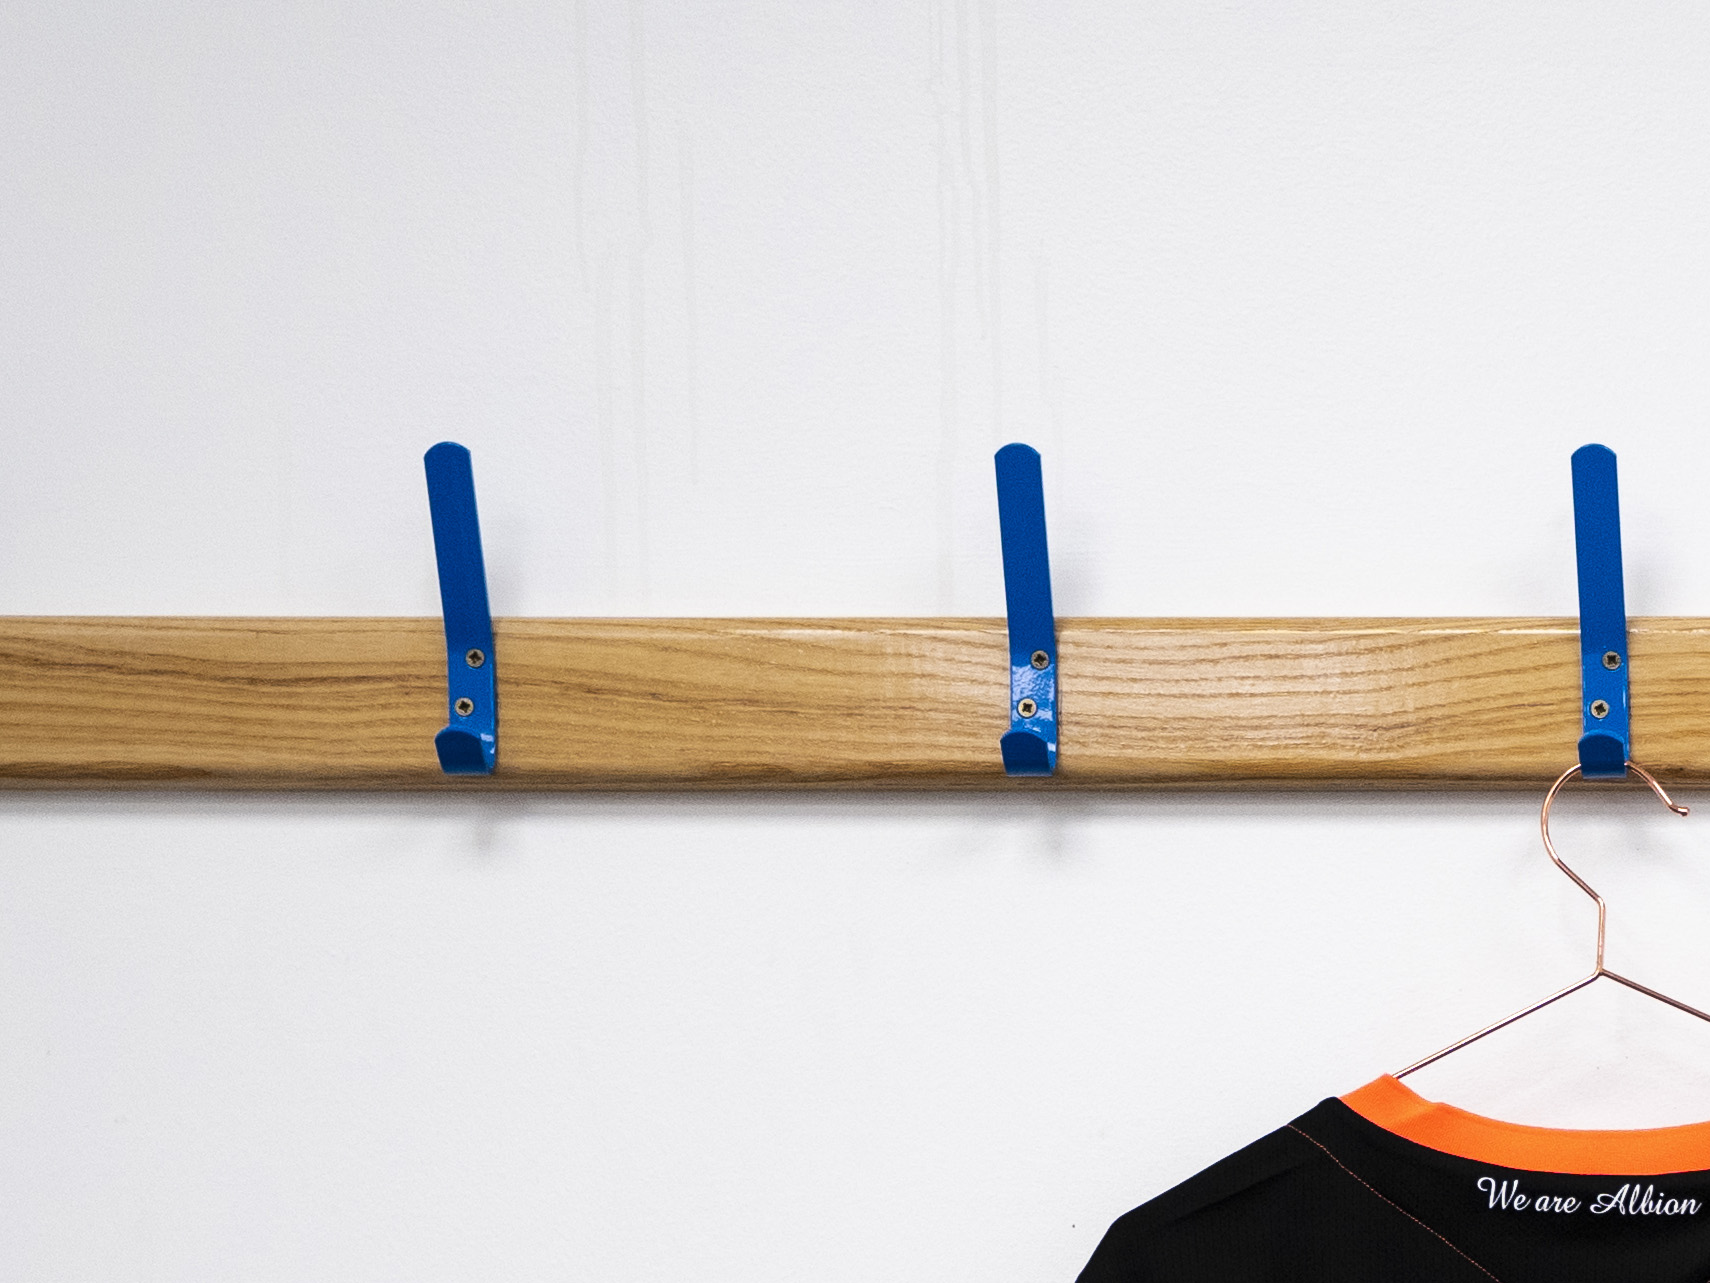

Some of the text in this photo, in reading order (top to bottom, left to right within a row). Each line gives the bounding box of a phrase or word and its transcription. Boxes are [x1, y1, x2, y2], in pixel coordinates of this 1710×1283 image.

[1477, 1177, 1702, 1215] We are Albion
